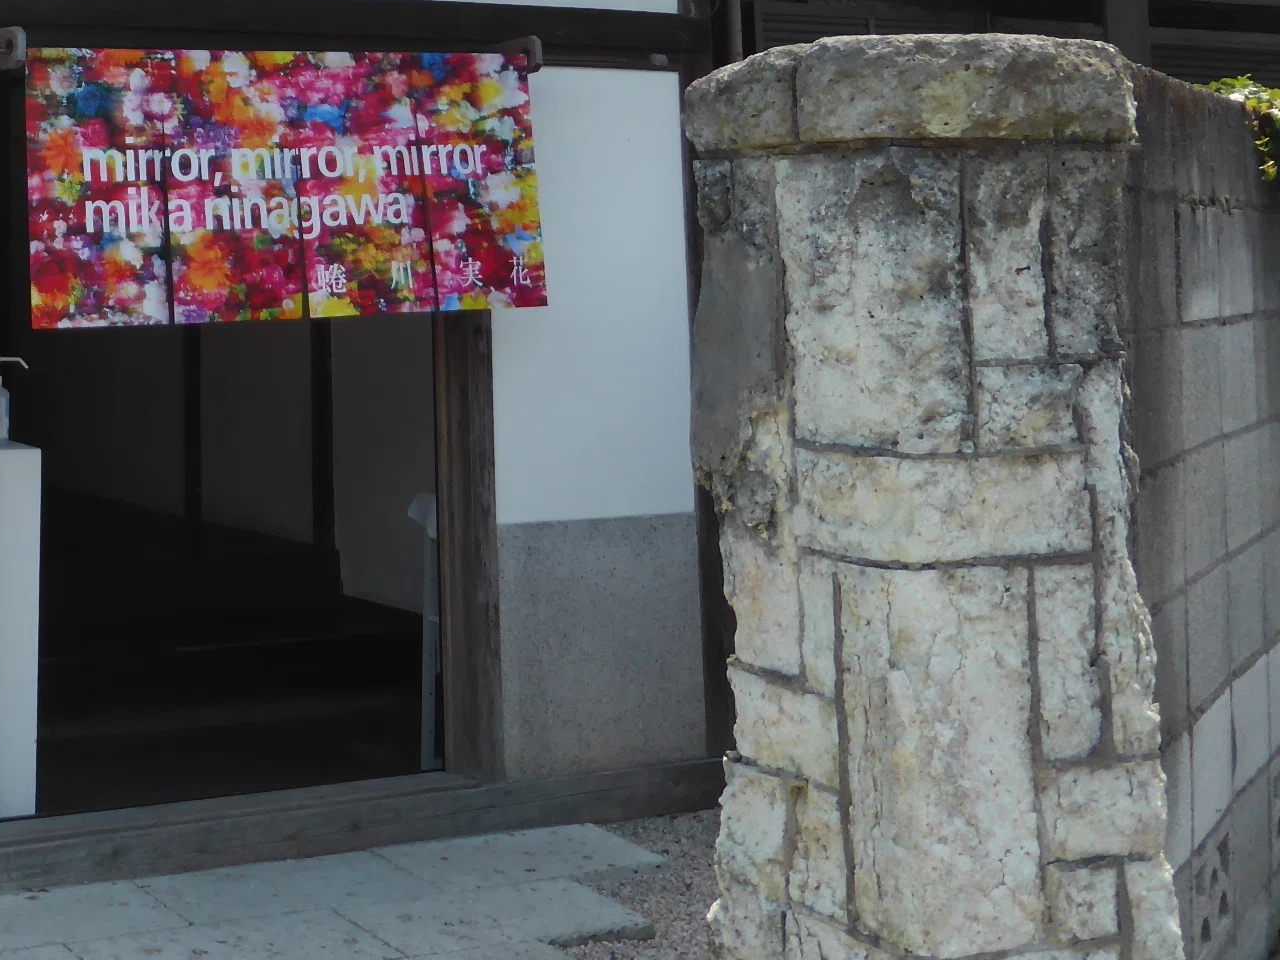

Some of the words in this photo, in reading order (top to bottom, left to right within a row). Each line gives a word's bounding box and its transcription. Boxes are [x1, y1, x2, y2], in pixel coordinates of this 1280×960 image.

[82, 136, 223, 187] mirror,
[231, 135, 366, 183] mirror,
[373, 133, 487, 176] mirror
[85, 187, 192, 233] mika
[204, 185, 409, 240] ninagawa
